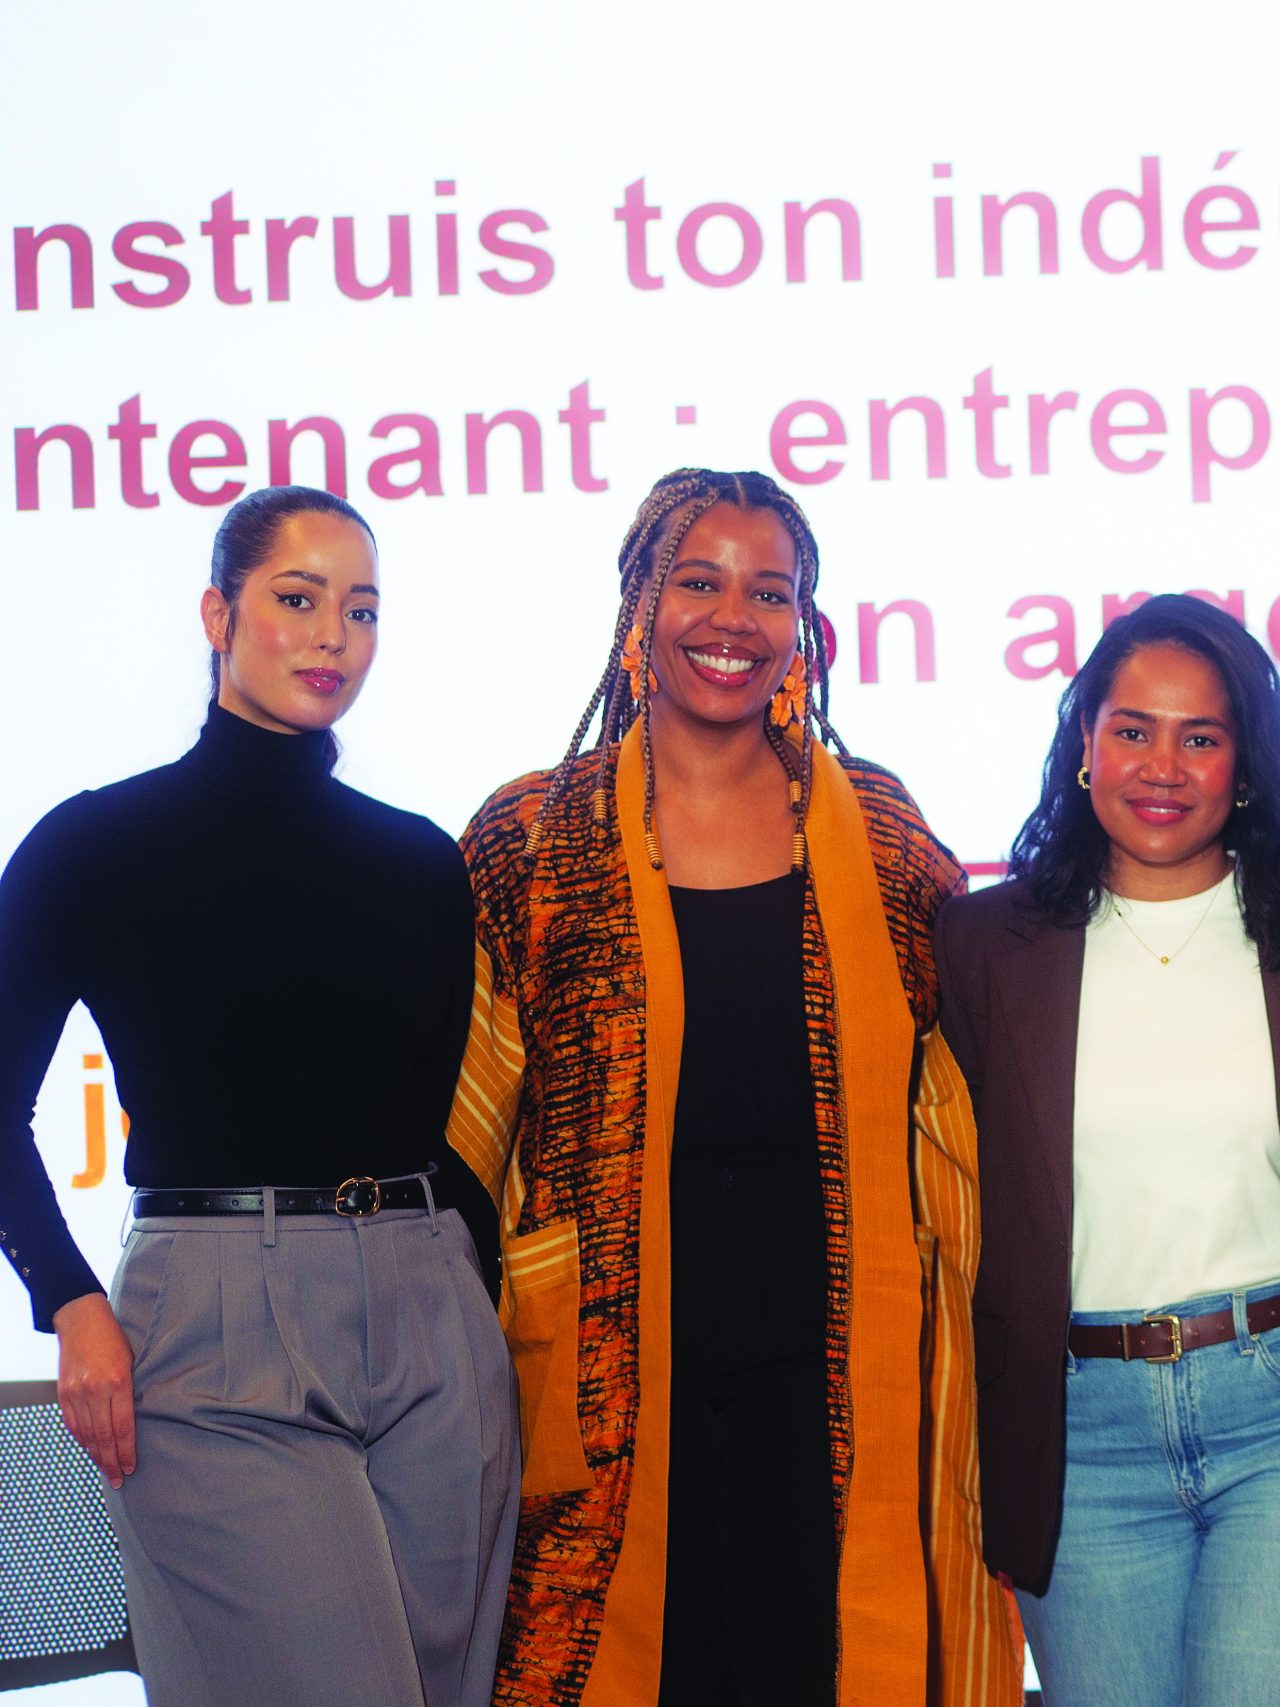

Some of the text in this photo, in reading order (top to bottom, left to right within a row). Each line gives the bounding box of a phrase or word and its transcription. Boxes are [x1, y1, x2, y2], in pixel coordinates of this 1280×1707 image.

[13, 179, 556, 312] nstruis
[613, 177, 862, 291] ton
[14, 382, 610, 512] ntenant
